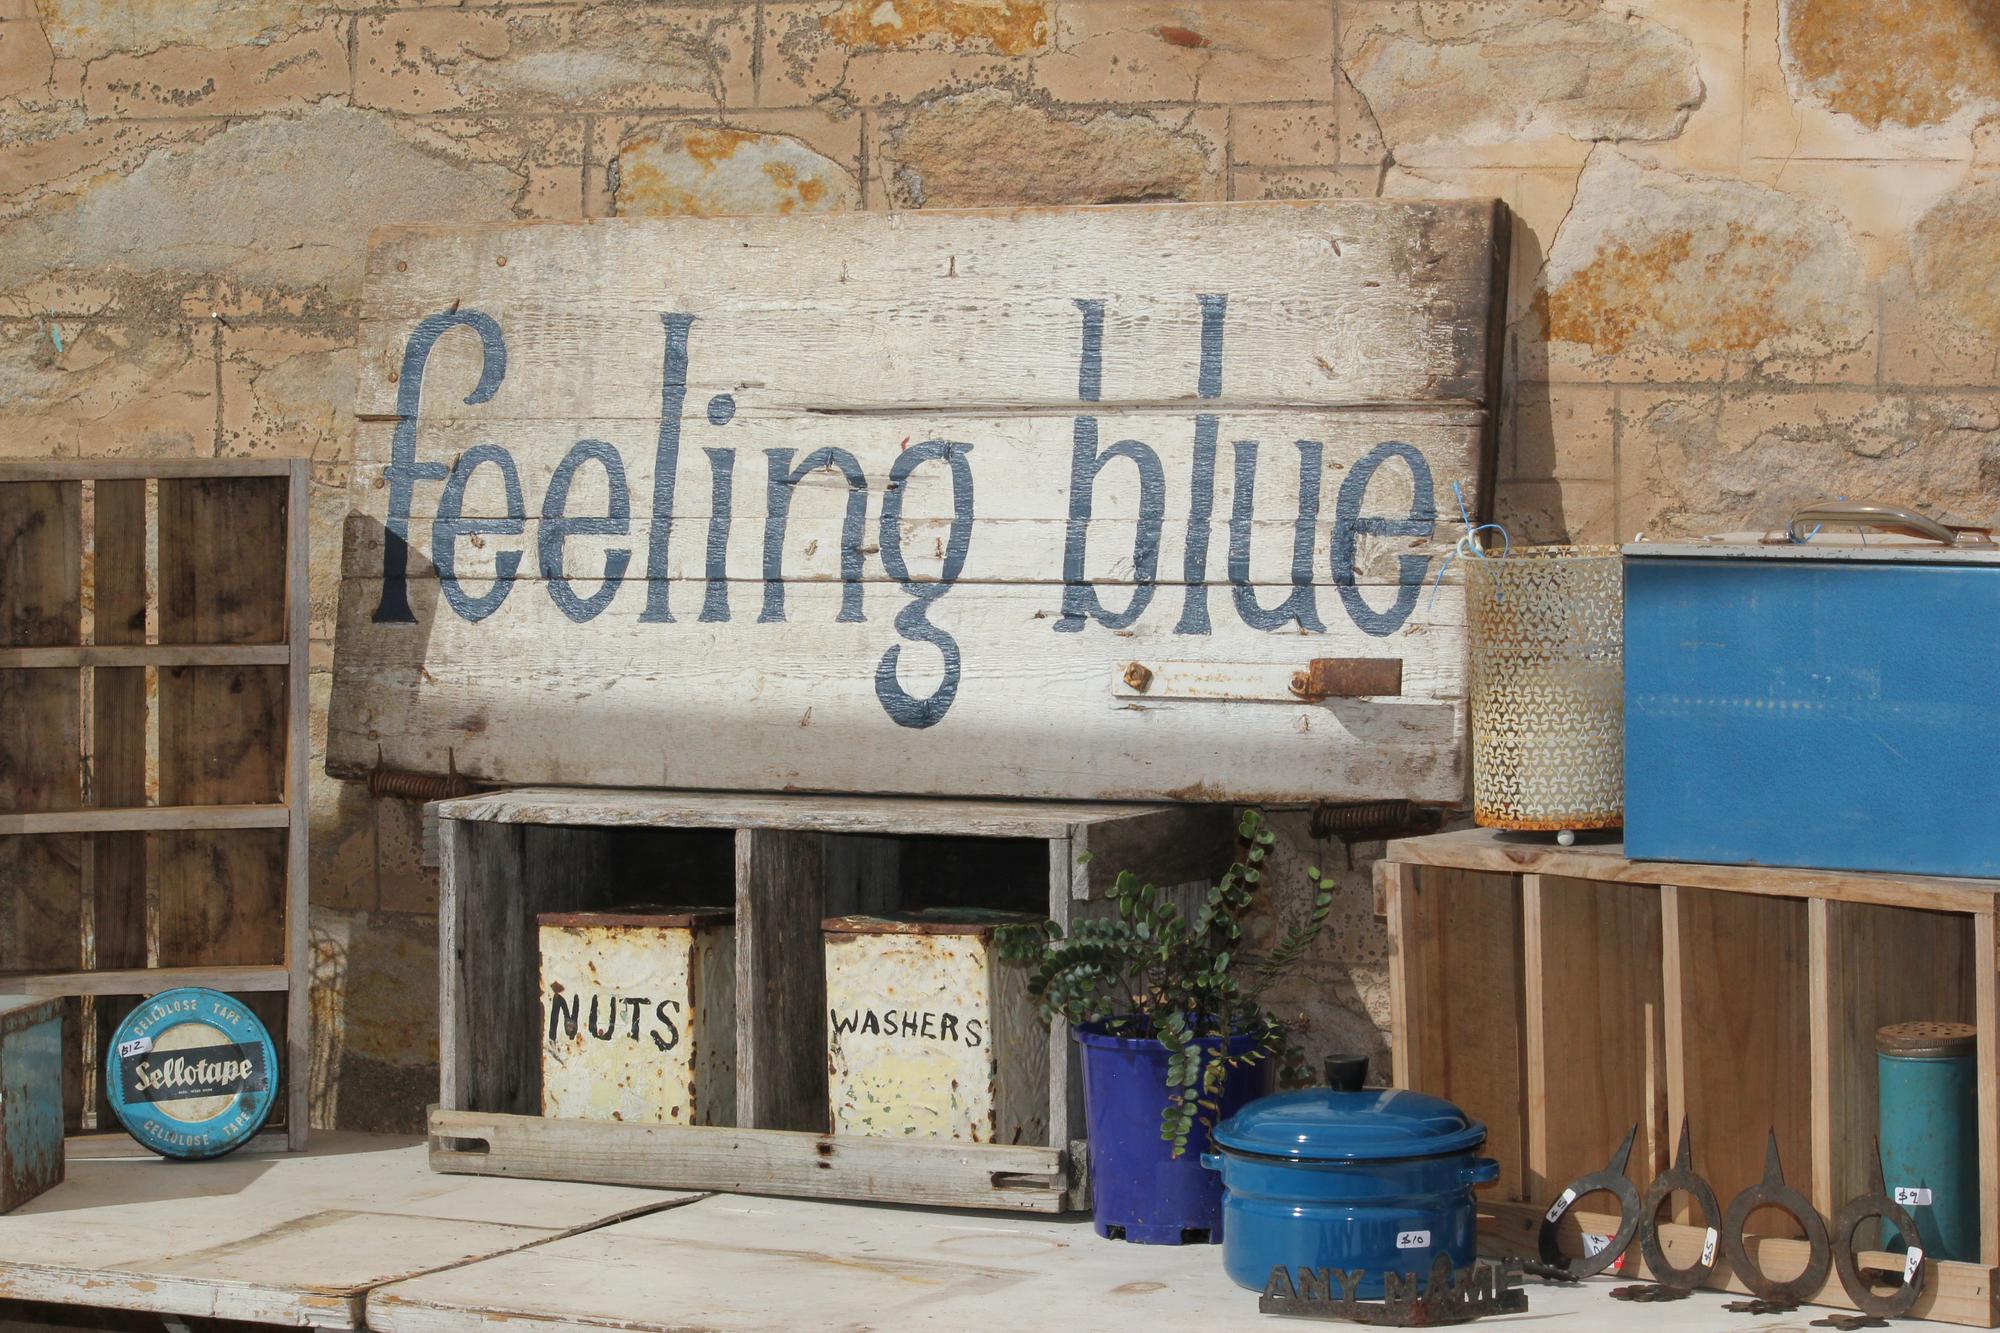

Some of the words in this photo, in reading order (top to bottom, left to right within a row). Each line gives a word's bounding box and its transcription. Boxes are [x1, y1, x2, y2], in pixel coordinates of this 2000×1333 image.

[372, 308, 974, 728] feeling
[1052, 293, 1436, 637] blue
[134, 999, 197, 1036] CELLULOSE
[213, 1003, 241, 1025] TAPE
[548, 993, 680, 1052] NUTS
[830, 1008, 983, 1048] WASHERS
[135, 1056, 253, 1091] Sellotape
[143, 1120, 209, 1145] CELLULOSE
[223, 1111, 250, 1136] TAPE
[1262, 1264, 1365, 1302] ANY
[1384, 1252, 1524, 1304] NAME
